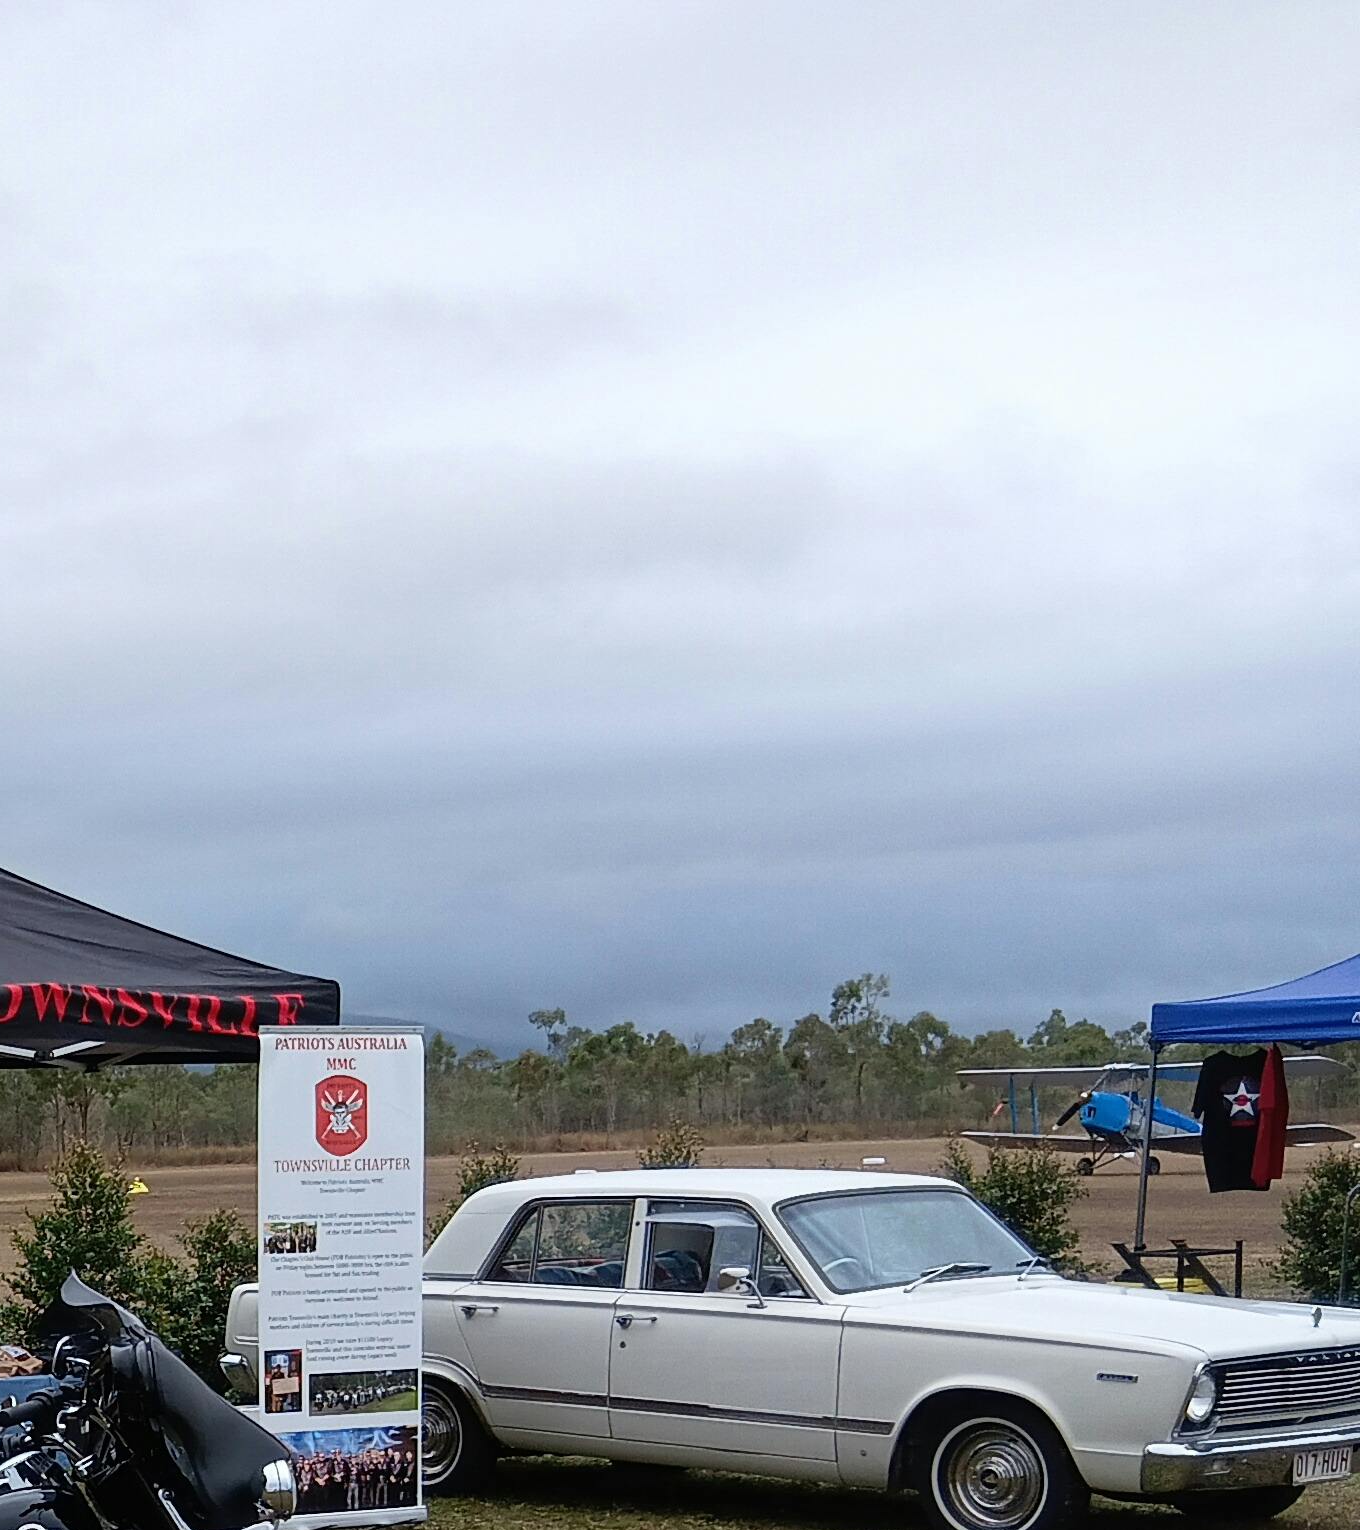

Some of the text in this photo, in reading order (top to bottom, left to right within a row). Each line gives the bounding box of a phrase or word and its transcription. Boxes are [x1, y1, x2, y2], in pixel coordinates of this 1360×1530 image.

[275, 1037, 407, 1050] PATRIOTS AUSTRALIA
[327, 1057, 357, 1070] MMC
[275, 1158, 411, 1173] TOWNSVILLE CHAPTER
